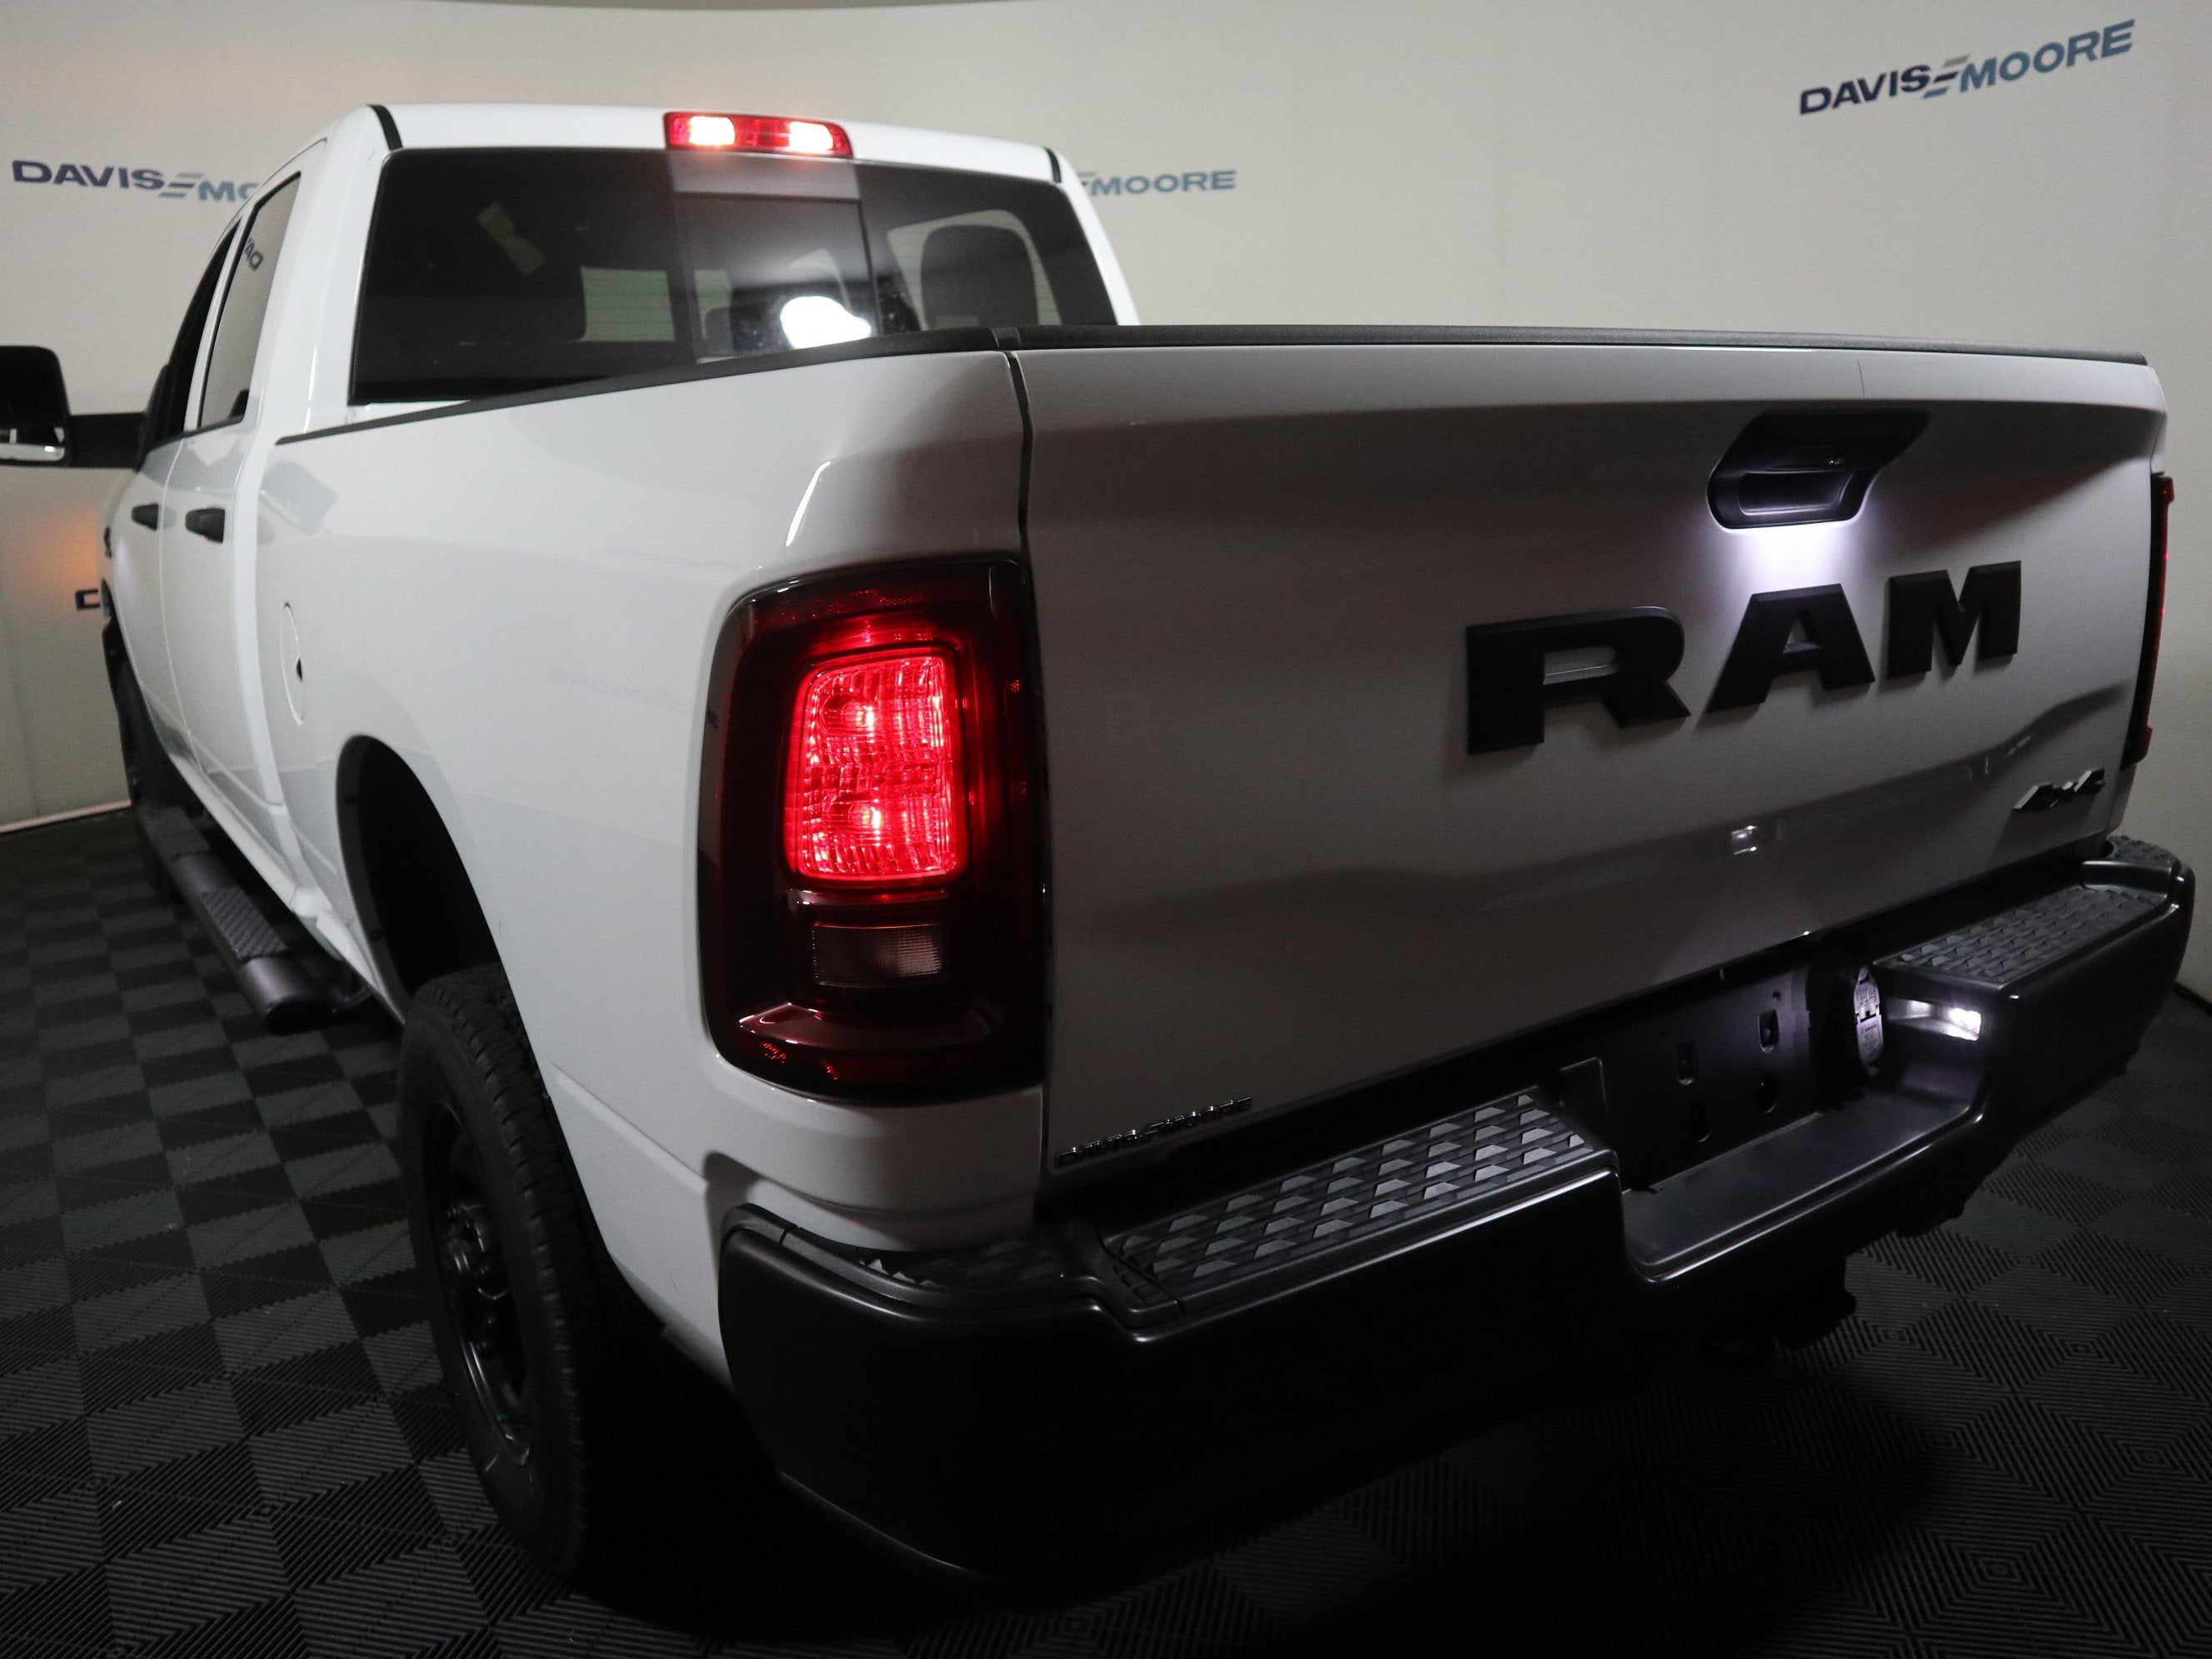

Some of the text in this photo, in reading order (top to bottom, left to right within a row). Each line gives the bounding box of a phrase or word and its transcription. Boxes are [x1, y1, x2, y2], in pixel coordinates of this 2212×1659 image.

[1800, 19, 2135, 115] DAVIS MOORE
[12, 160, 165, 190] DAVIS
[1090, 169, 1236, 197] MOORE
[1466, 560, 2021, 755] RAM
